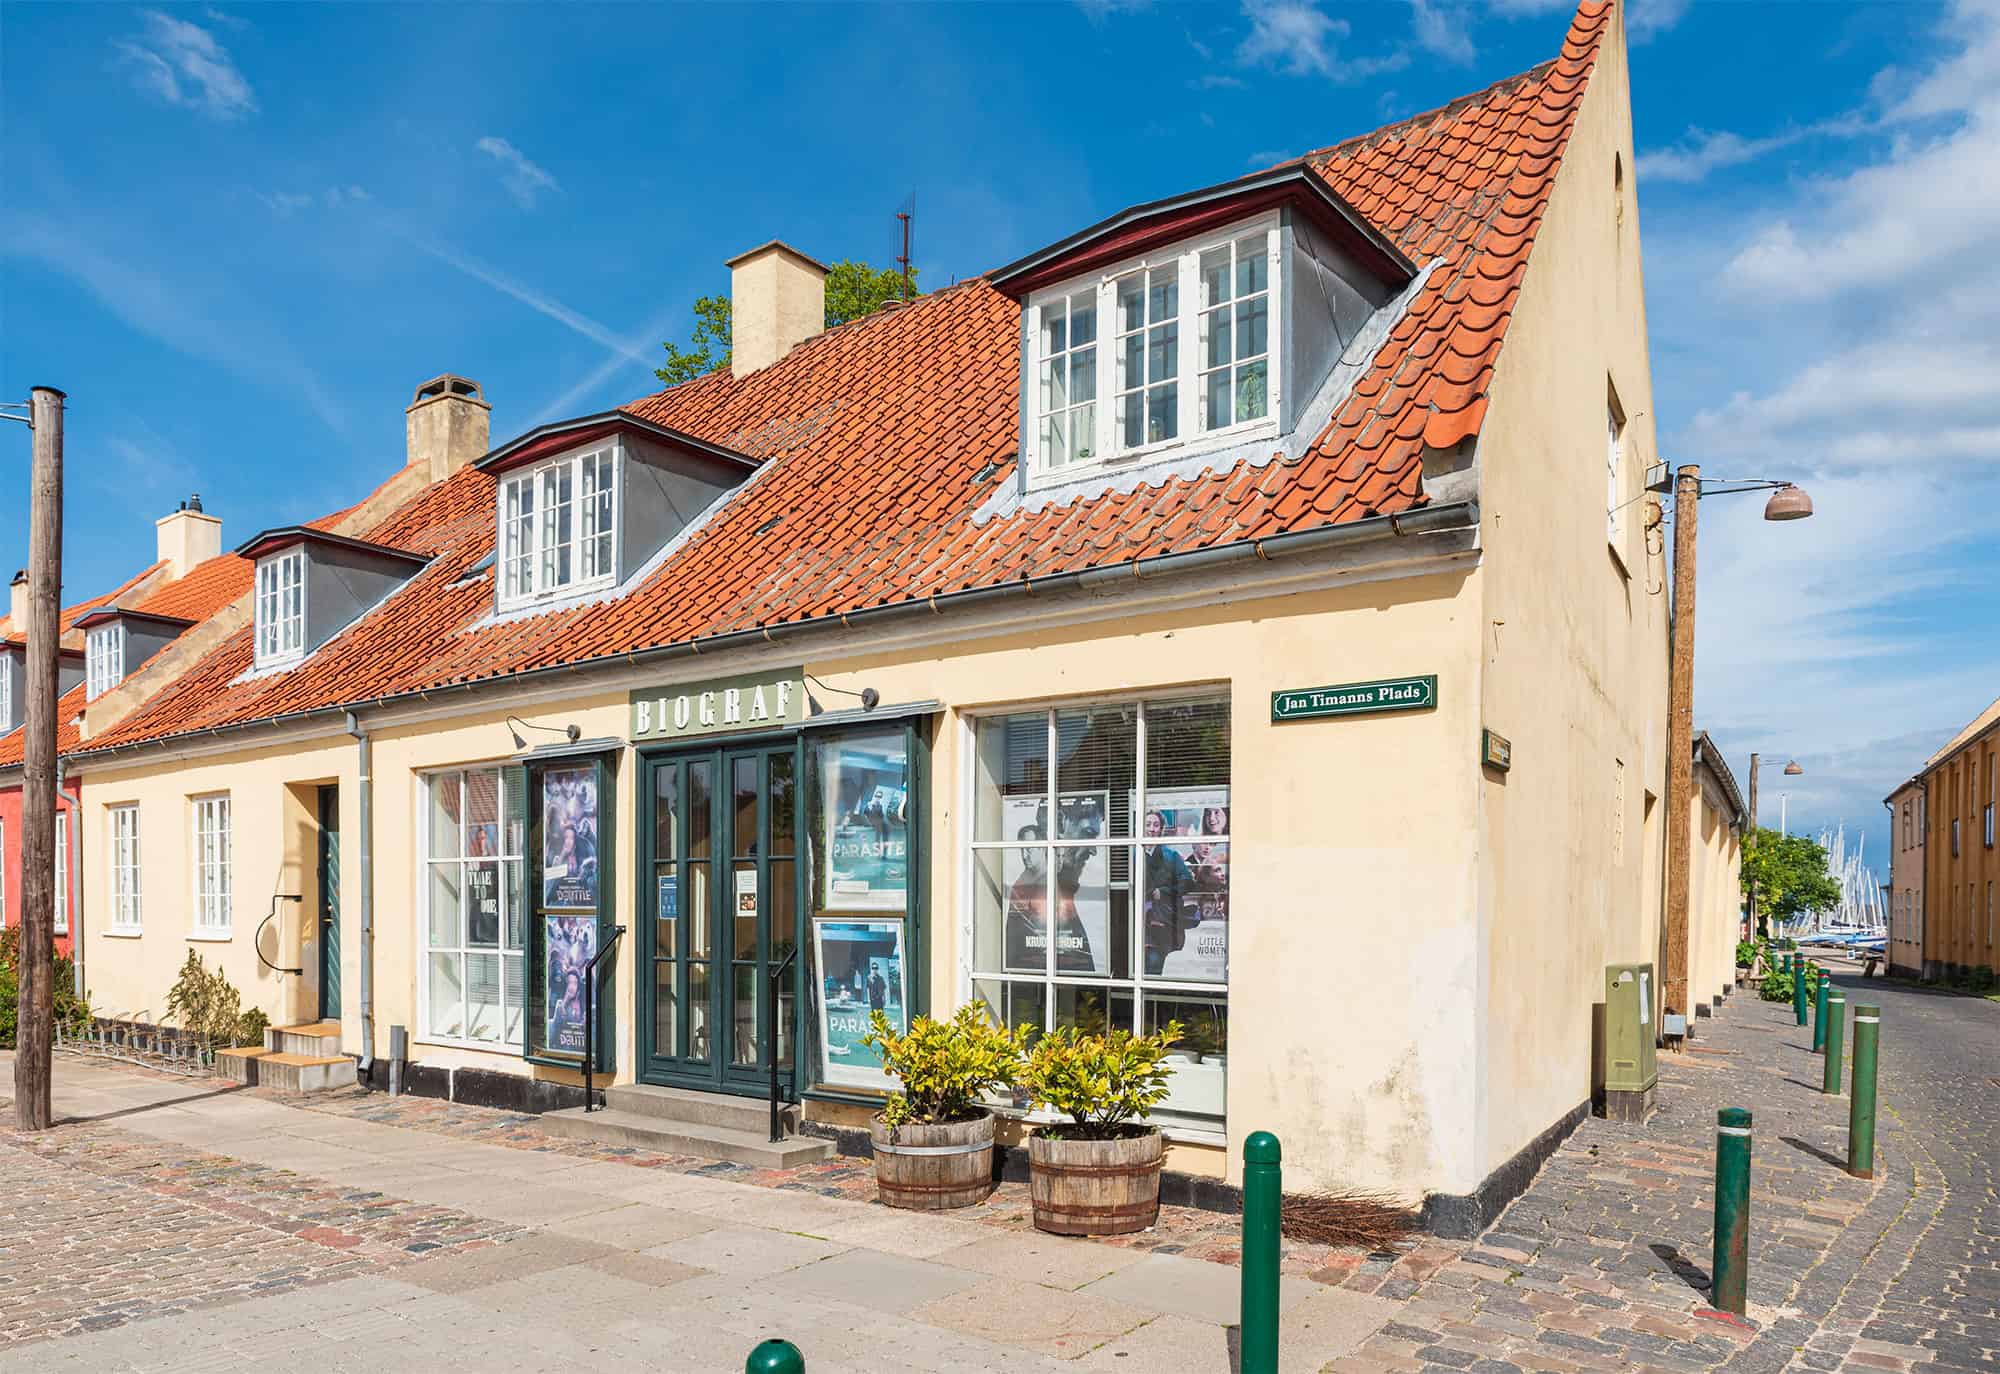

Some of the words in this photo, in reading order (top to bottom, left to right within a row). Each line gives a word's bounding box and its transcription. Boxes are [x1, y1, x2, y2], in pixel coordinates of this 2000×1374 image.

[1284, 697, 1307, 712] Jan
[1310, 693, 1373, 707] Timanns
[1378, 685, 1420, 701] Plads
[636, 680, 793, 735] BIOGRAF
[833, 841, 905, 857] PARASITE
[474, 885, 487, 899] TO
[1199, 936, 1224, 946] LITTLE
